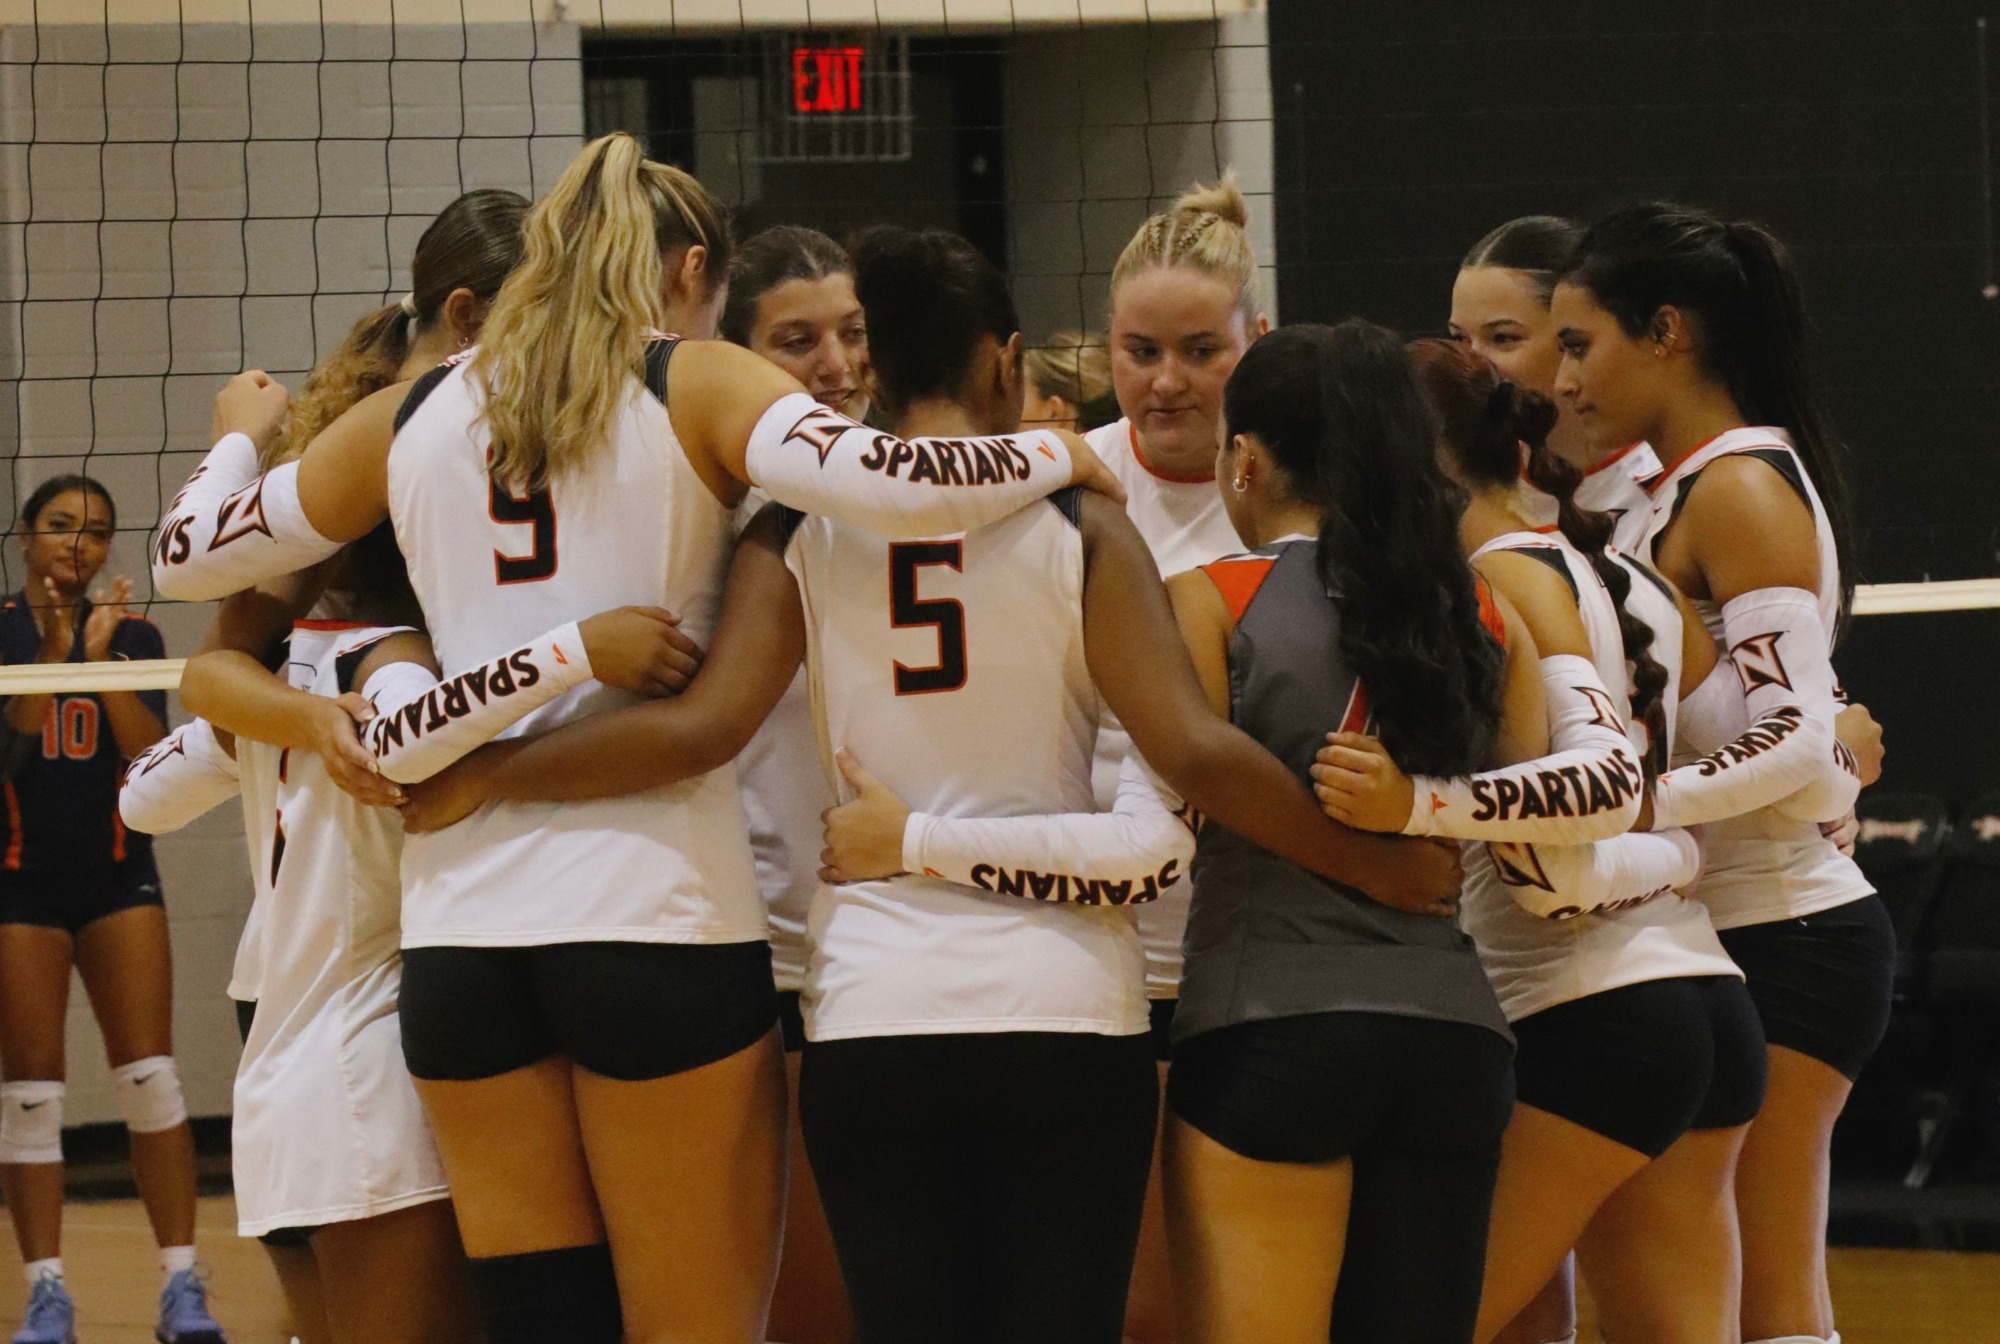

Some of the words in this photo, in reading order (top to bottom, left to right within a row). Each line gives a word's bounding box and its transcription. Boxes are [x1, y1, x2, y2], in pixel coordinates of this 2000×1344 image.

[793, 47, 864, 112] EXIT
[860, 435, 1031, 486] SPARTANS
[889, 539, 968, 696] 5
[42, 697, 98, 760] 10
[373, 648, 540, 758] SPARTANS
[1471, 748, 1645, 822] SPARTANS
